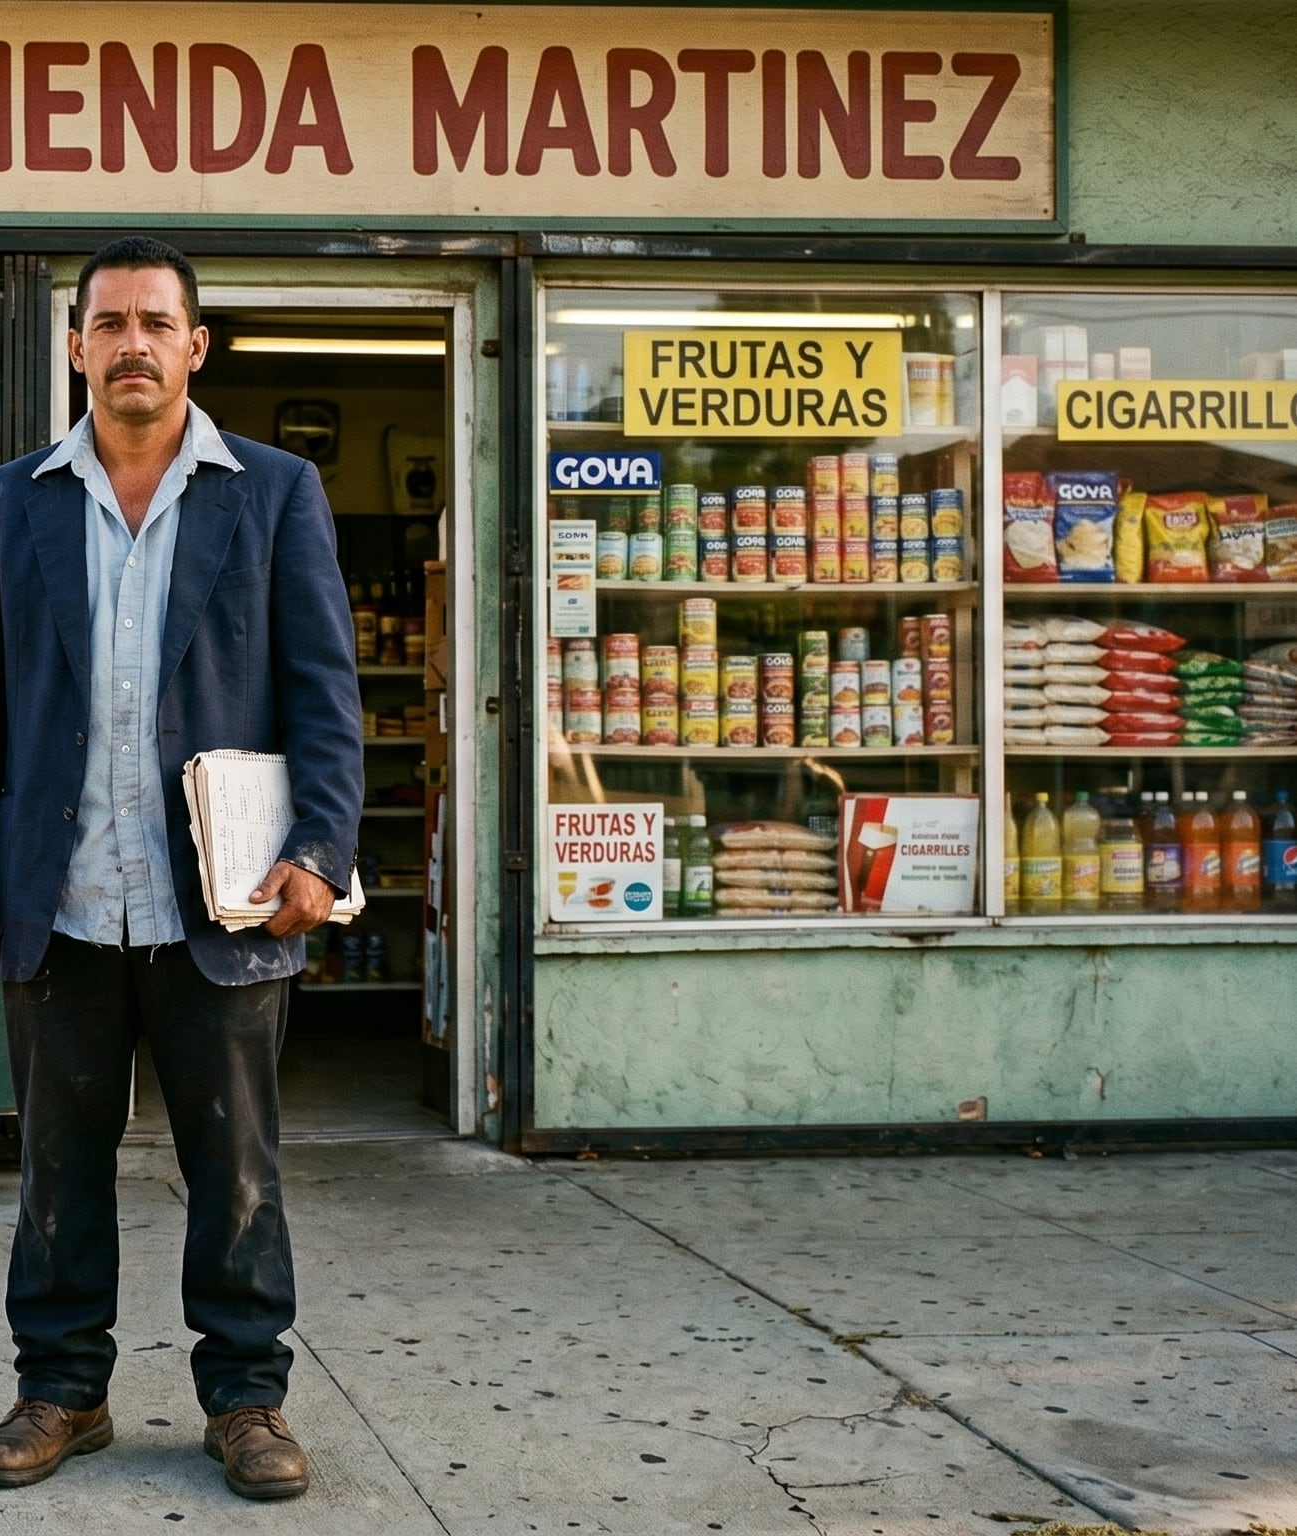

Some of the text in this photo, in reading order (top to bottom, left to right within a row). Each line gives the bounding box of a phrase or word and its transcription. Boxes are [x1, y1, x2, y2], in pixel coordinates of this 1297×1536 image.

[410, 43, 1021, 181] MARTINEZ
[651, 340, 874, 379] FRUTAS Y
[638, 387, 888, 427] VERDURAS
[1065, 389, 1297, 430] CIGARRILL
[555, 812, 656, 837] FRUTAS Y
[555, 841, 656, 863] VERDURAS
[900, 844, 971, 856] CIGARRILLES
